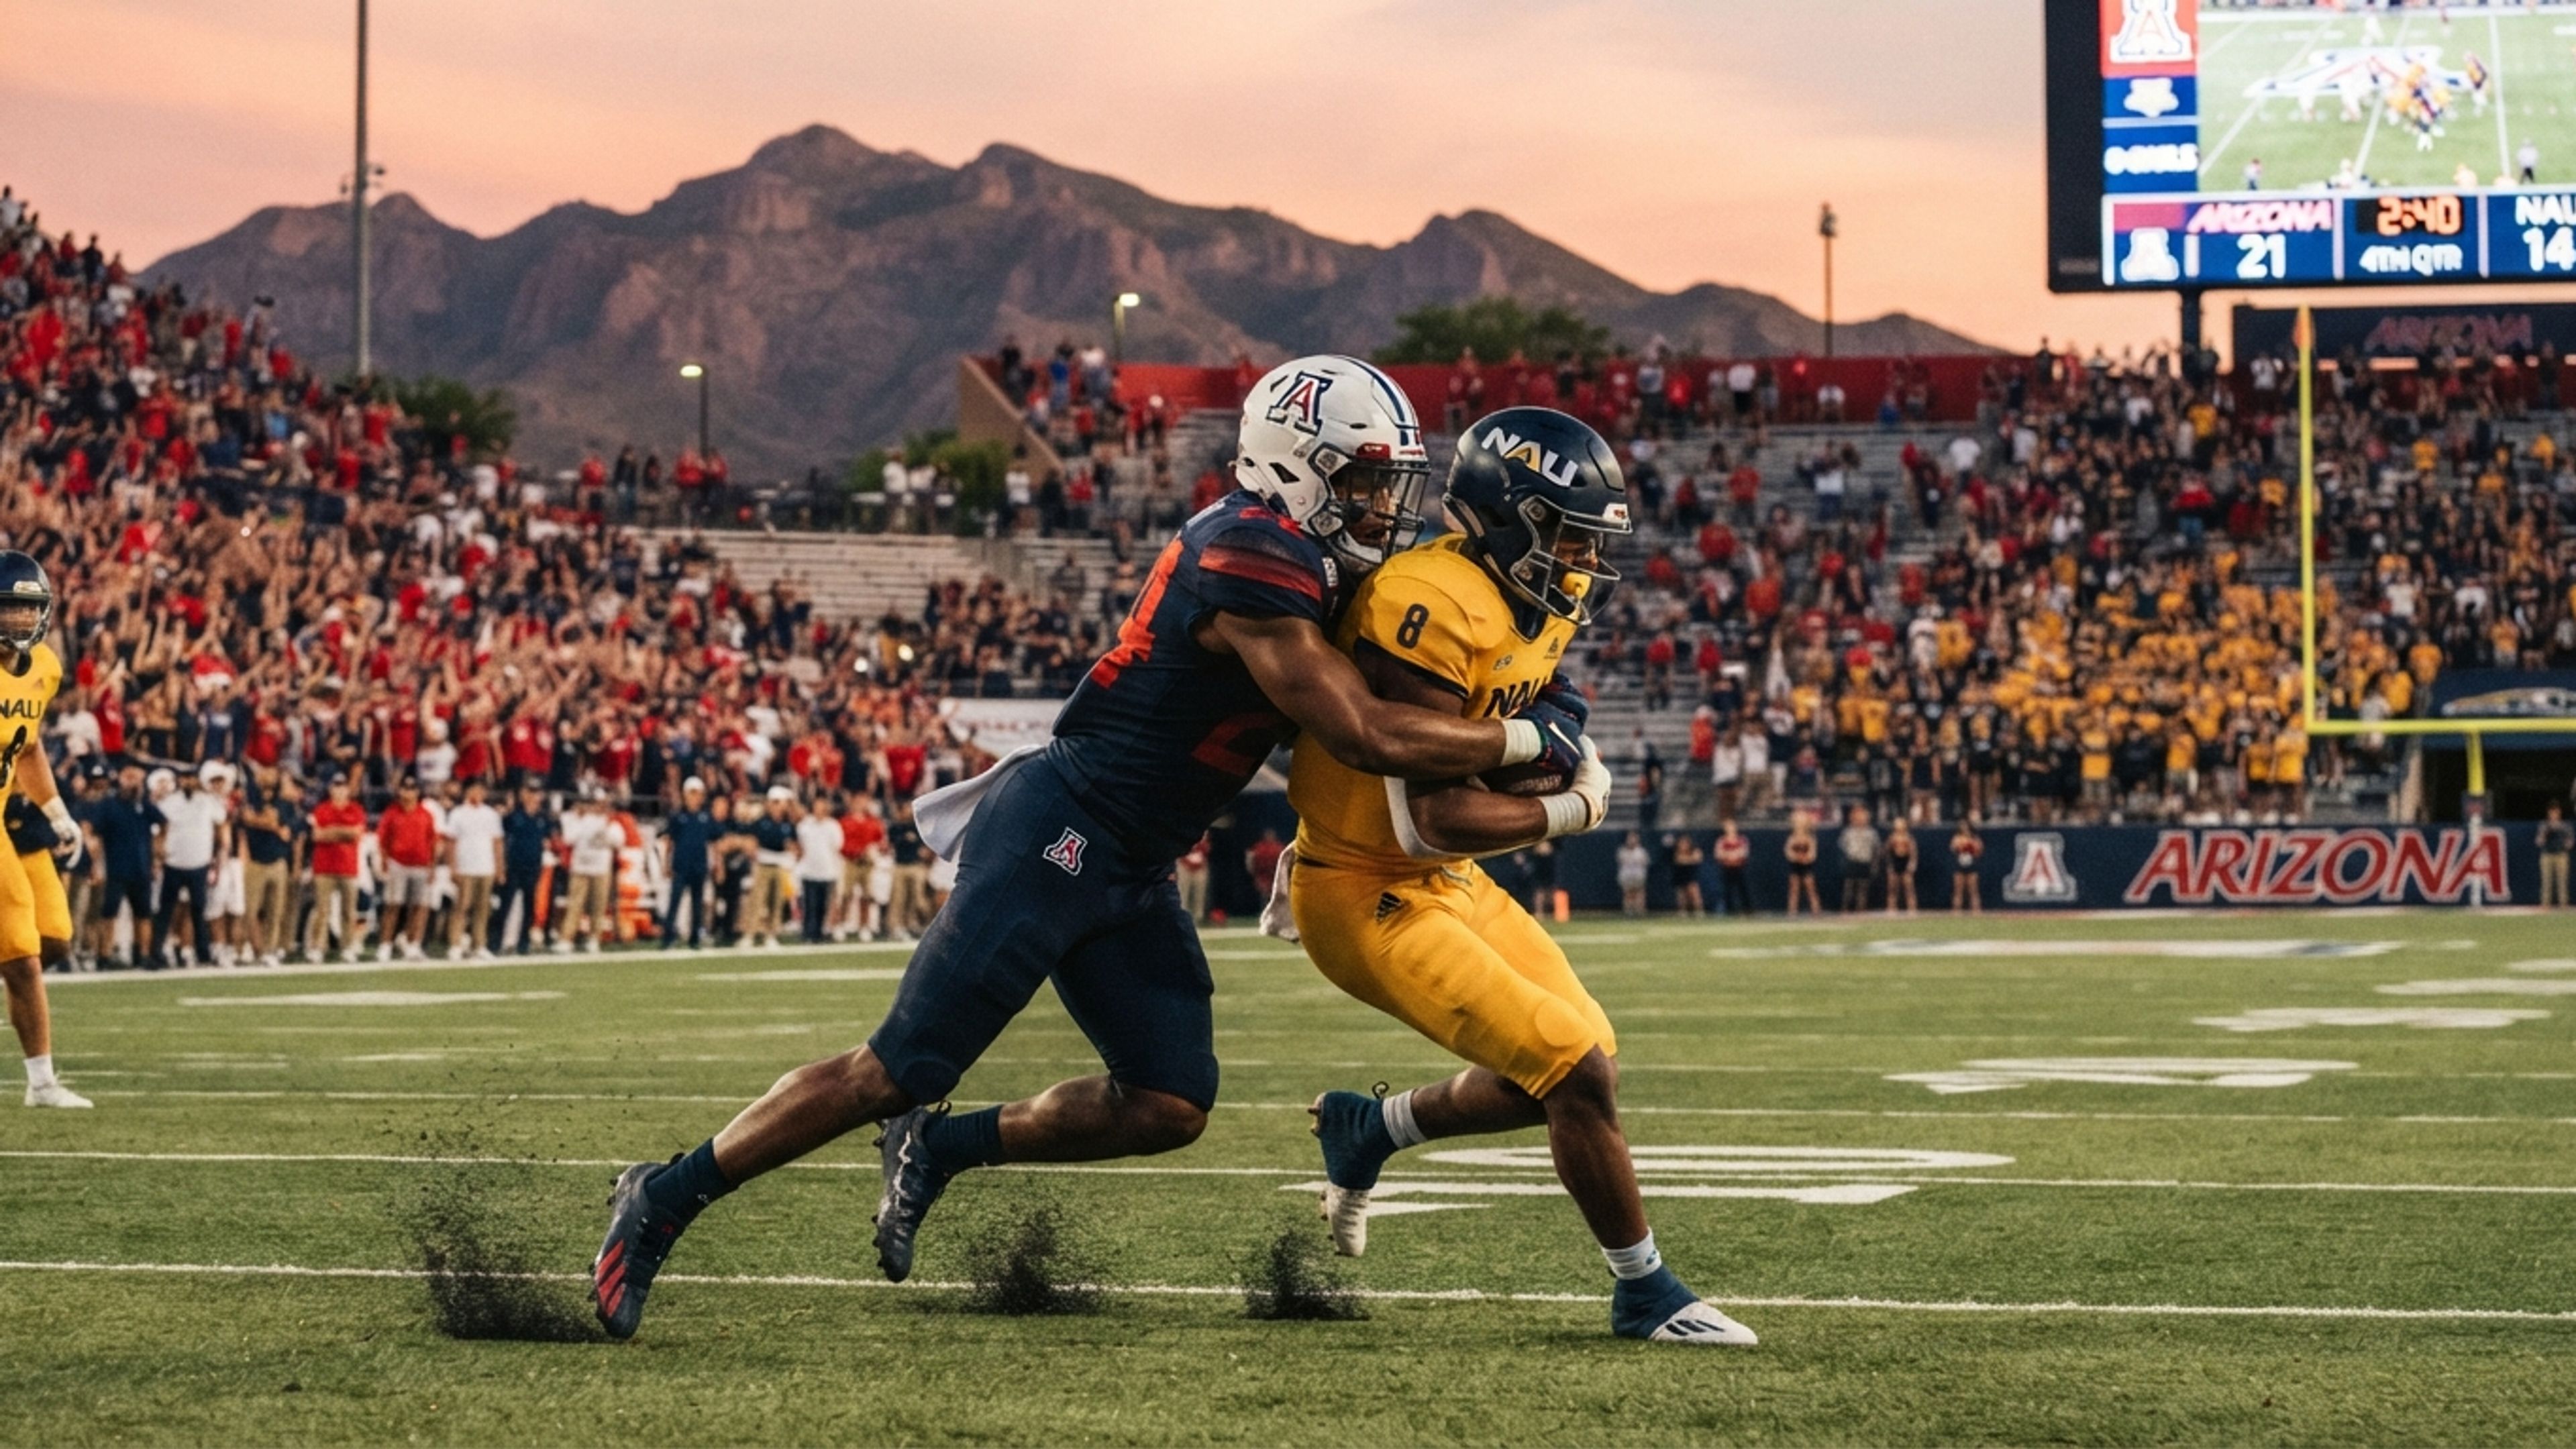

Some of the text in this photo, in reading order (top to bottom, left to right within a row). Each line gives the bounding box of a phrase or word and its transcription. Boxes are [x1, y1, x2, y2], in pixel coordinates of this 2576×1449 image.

[2377, 197, 2461, 236] 2:40
[2516, 195, 2576, 226] NAU
[2236, 233, 2286, 278] 21
[2522, 227, 2576, 272] 14
[1265, 370, 1334, 437] A
[1481, 426, 1579, 487] NAU
[1396, 603, 1429, 650] 8
[0, 698, 42, 720] NAU
[1042, 826, 1088, 877] A
[2123, 828, 2511, 903] ARIZONA
